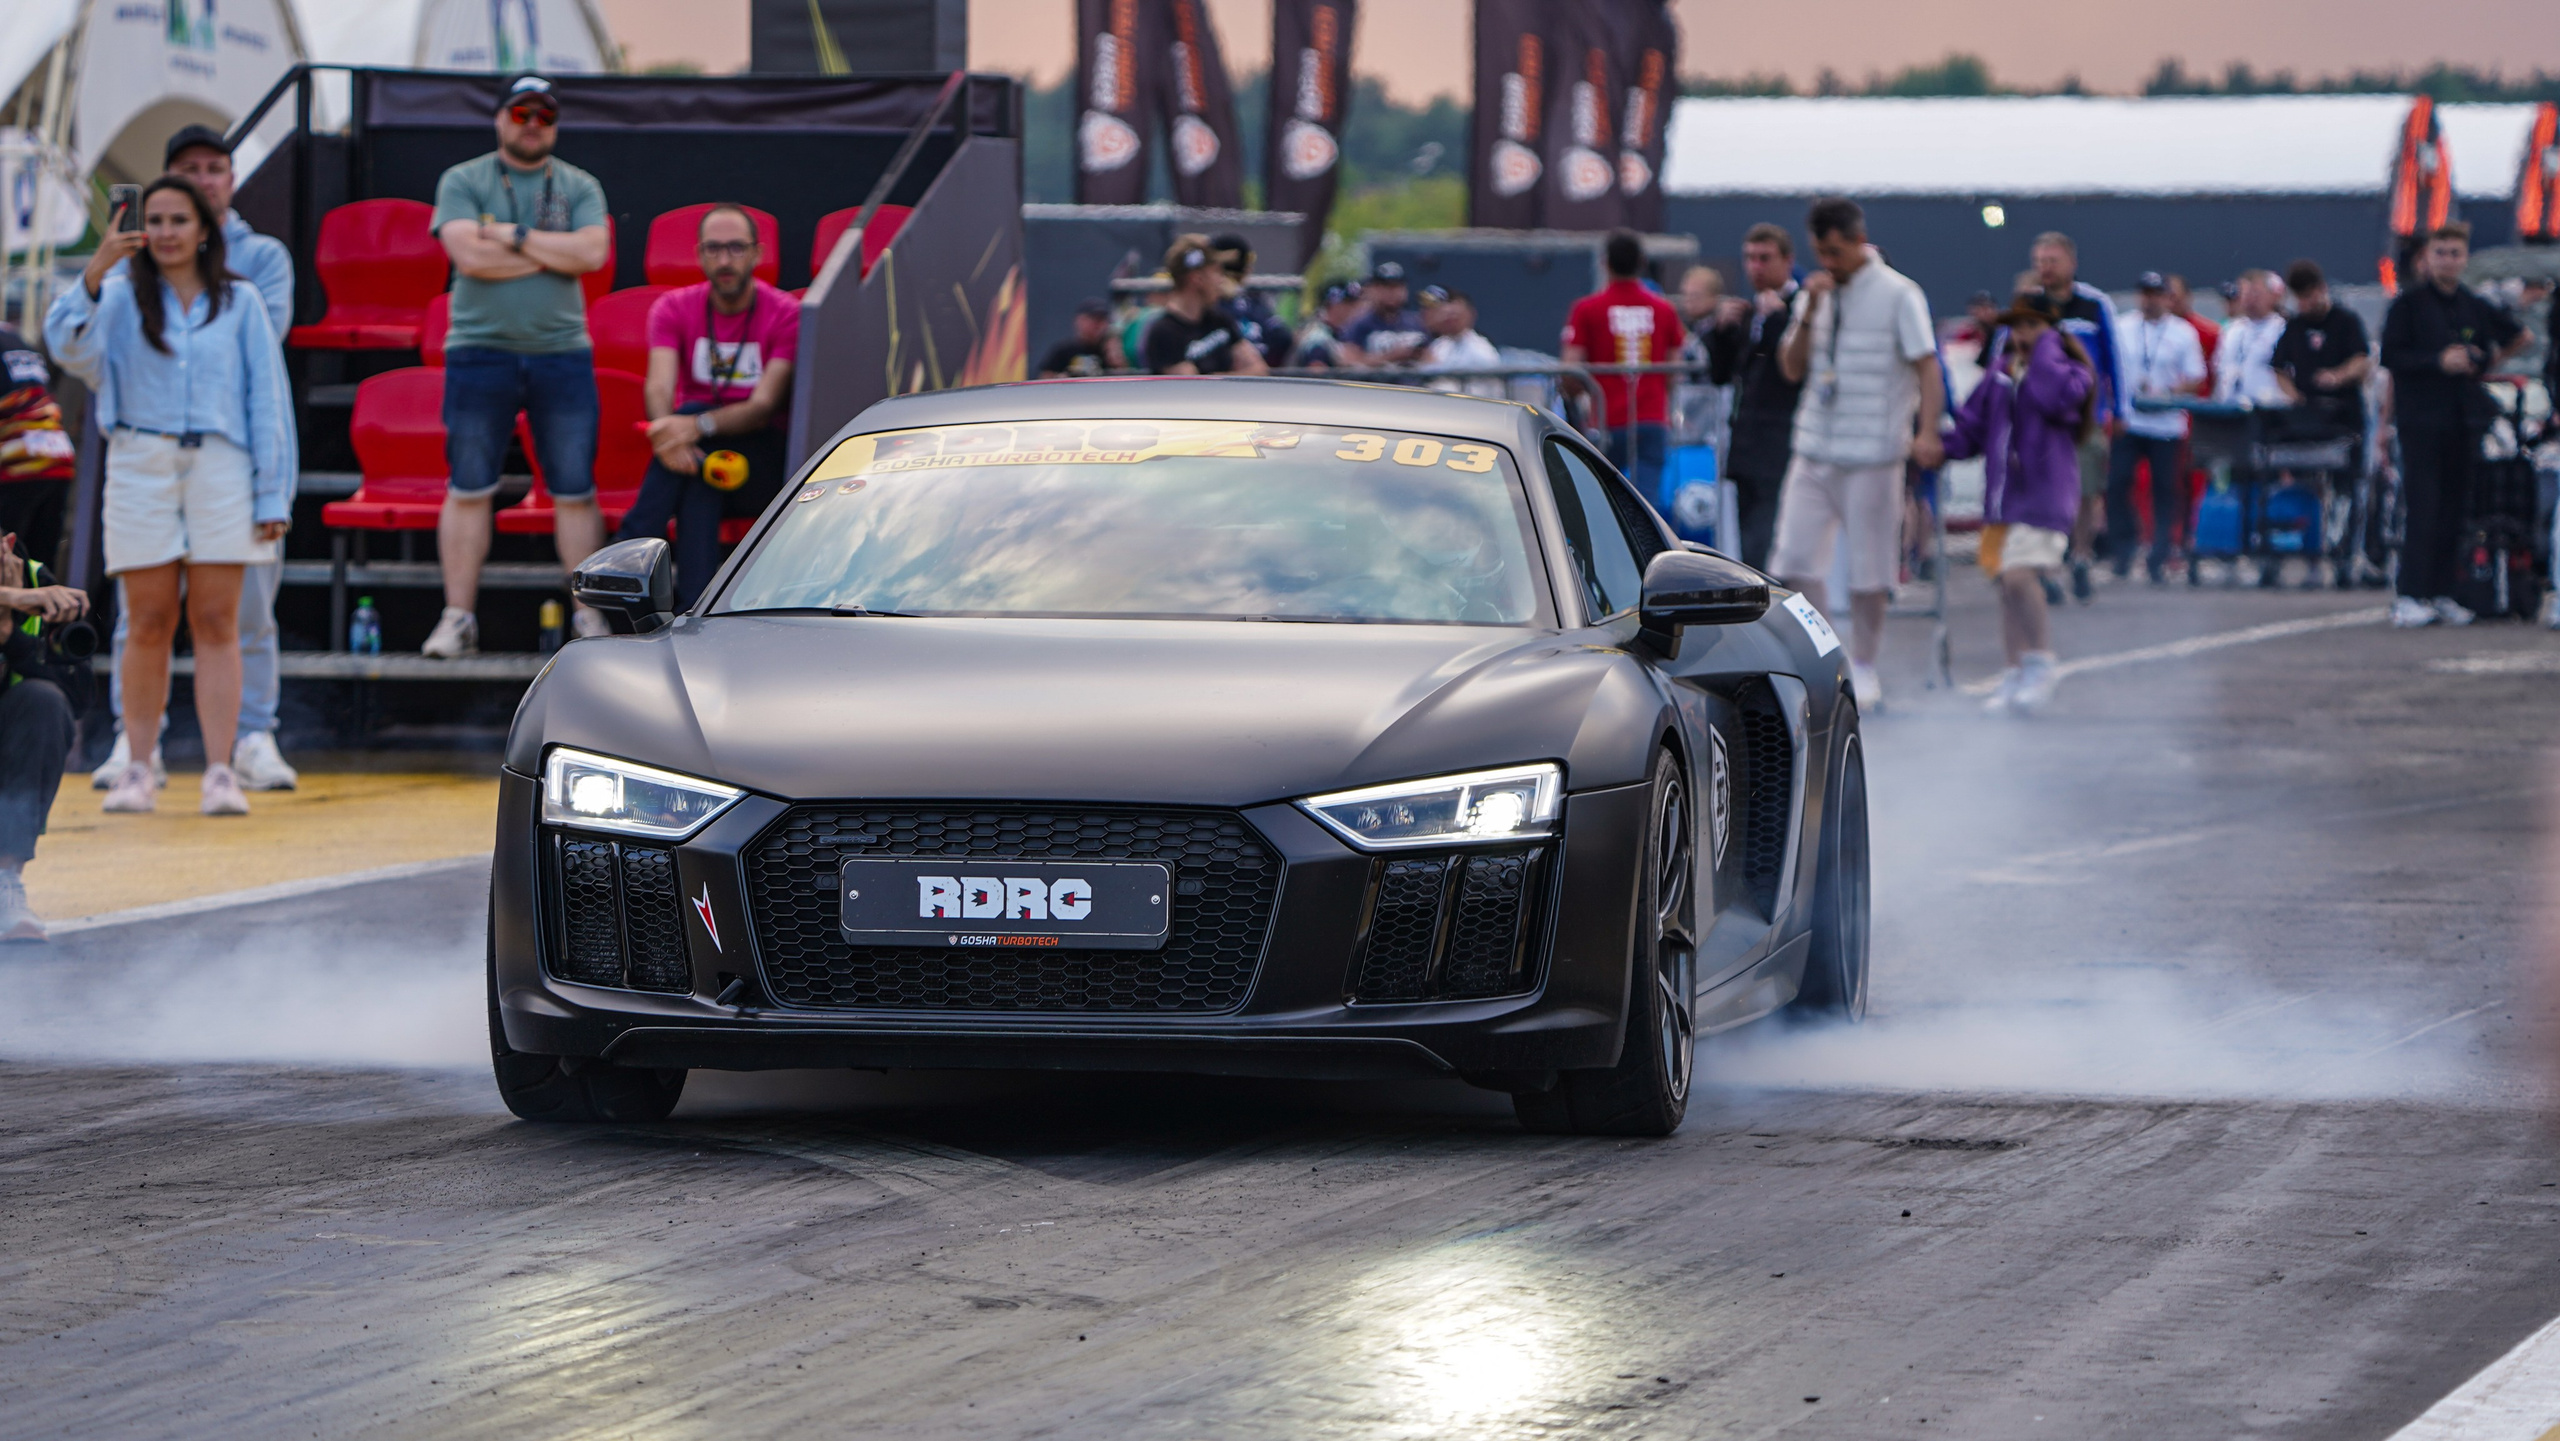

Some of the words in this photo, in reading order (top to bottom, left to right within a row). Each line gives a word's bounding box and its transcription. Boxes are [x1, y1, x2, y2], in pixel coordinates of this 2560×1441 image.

[872, 451, 1138, 471] GOSHATURBOTECH
[873, 425, 1160, 461] RDRC
[1335, 433, 1499, 474] 303
[917, 876, 1092, 920] RDRC
[960, 935, 1059, 946] GOSHATURBOTECH
